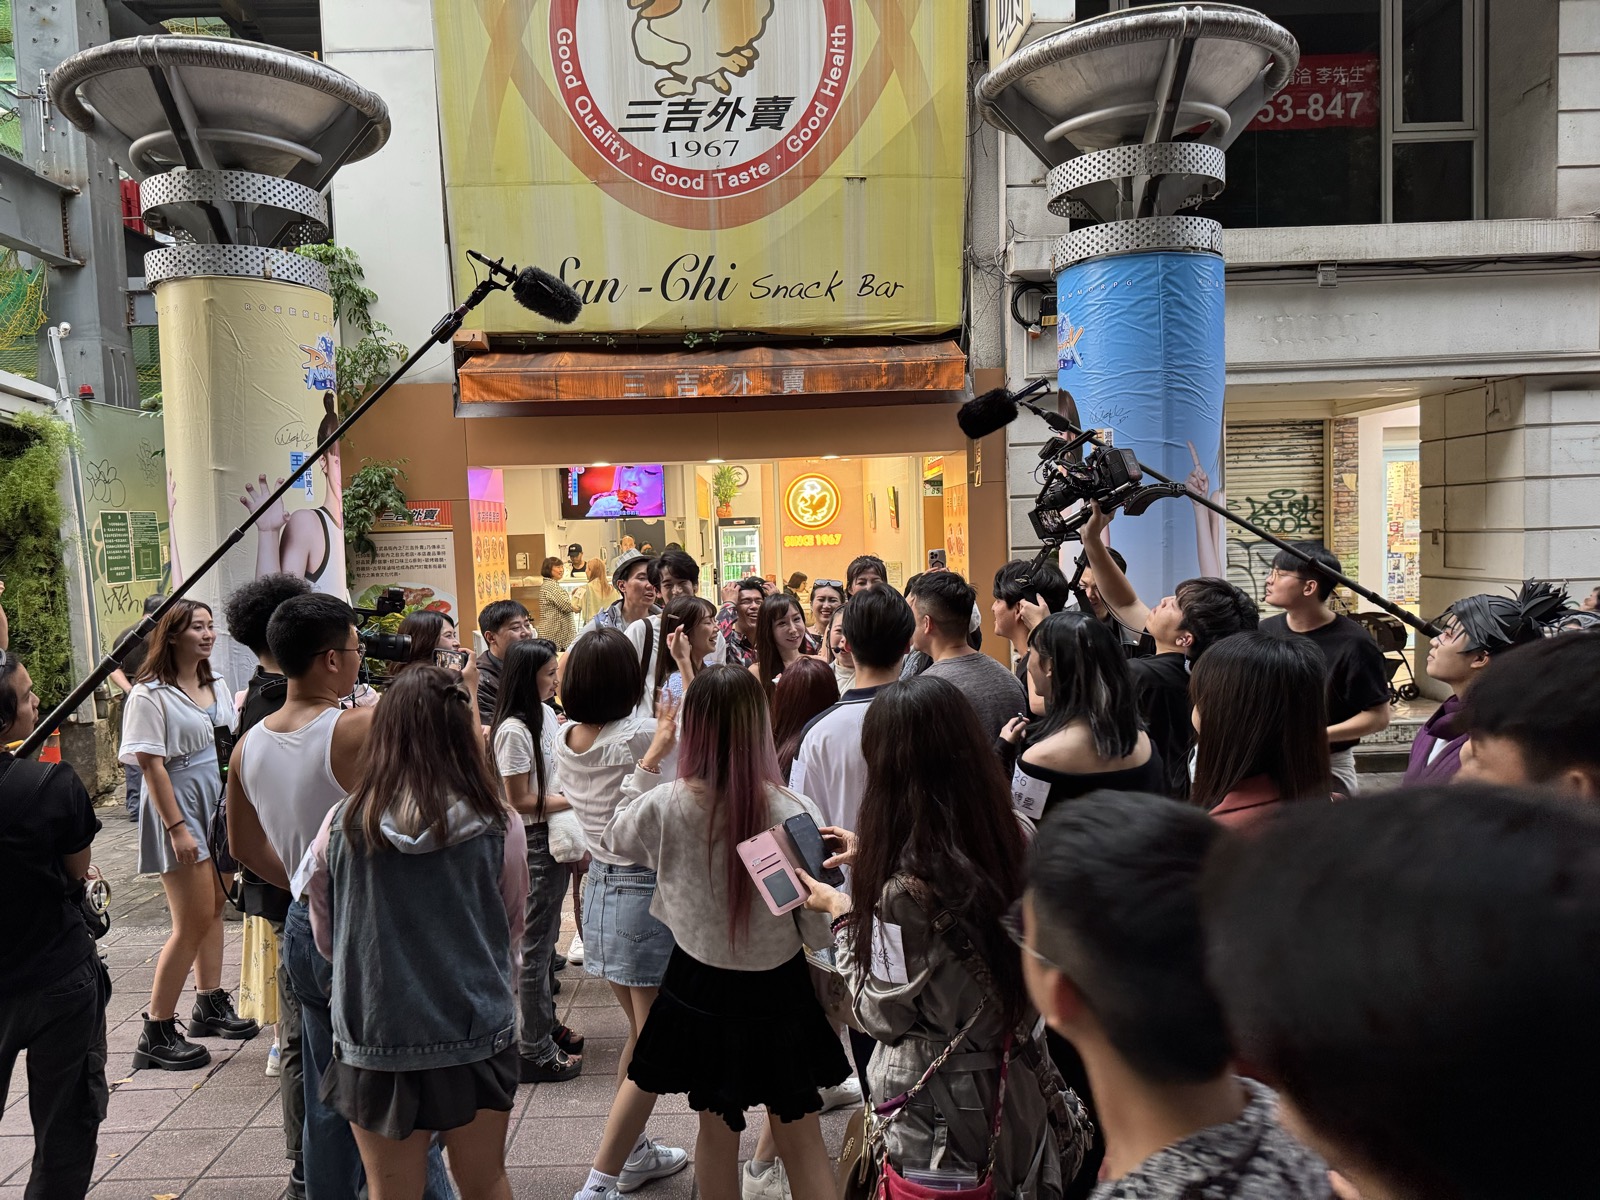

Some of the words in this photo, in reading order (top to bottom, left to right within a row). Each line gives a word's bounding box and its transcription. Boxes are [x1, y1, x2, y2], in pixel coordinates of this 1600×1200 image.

[556, 27, 582, 89] Good
[574, 95, 631, 163] Quality
[786, 101, 829, 152] Good
[820, 24, 846, 97] Health
[617, 95, 798, 134] 三吉外賣
[668, 139, 740, 159] 1967
[650, 164, 704, 191] Good
[713, 162, 771, 190] Taste
[749, 269, 844, 302] Snack
[856, 273, 905, 299] Bar
[623, 368, 805, 397] 三吉外賣
[783, 533, 815, 548] SINCE
[815, 533, 843, 546] 1967
